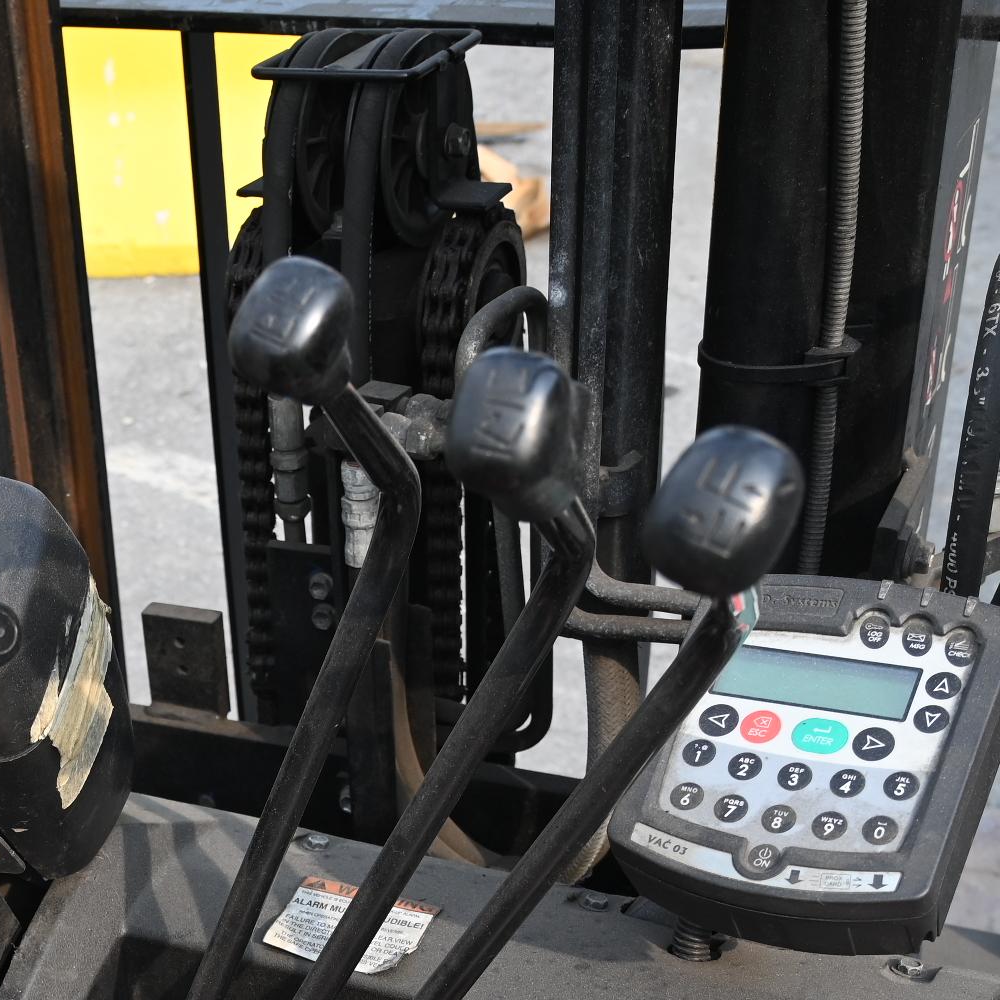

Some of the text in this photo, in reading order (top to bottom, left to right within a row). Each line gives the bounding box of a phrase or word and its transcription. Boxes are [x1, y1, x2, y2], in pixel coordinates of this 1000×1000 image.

[747, 727, 768, 737] ESC
[802, 734, 834, 746] ENTER
[694, 750, 702, 763] 1
[738, 757, 756, 765] ABC
[736, 764, 749, 776] 2
[788, 766, 805, 774] DEF
[787, 773, 799, 786] 3
[841, 773, 857, 781] GHI
[895, 776, 911, 784] JKL
[681, 785, 698, 794] MNO
[839, 780, 852, 794] 4
[893, 783, 907, 796] 5
[679, 793, 691, 806] 6
[723, 798, 745, 807] PQRS
[724, 805, 737, 818] 7
[773, 809, 789, 817] TUV
[771, 817, 783, 829] 8
[821, 815, 844, 826] WXYZ
[823, 823, 835, 836] 9
[873, 826, 885, 839] 0
[672, 844, 688, 856] 03
[753, 858, 771, 868] ON
[291, 895, 329, 910] ALARM
[328, 903, 346, 914] MU
[284, 913, 315, 925] FAILURE
[393, 936, 413, 946] VIEW
